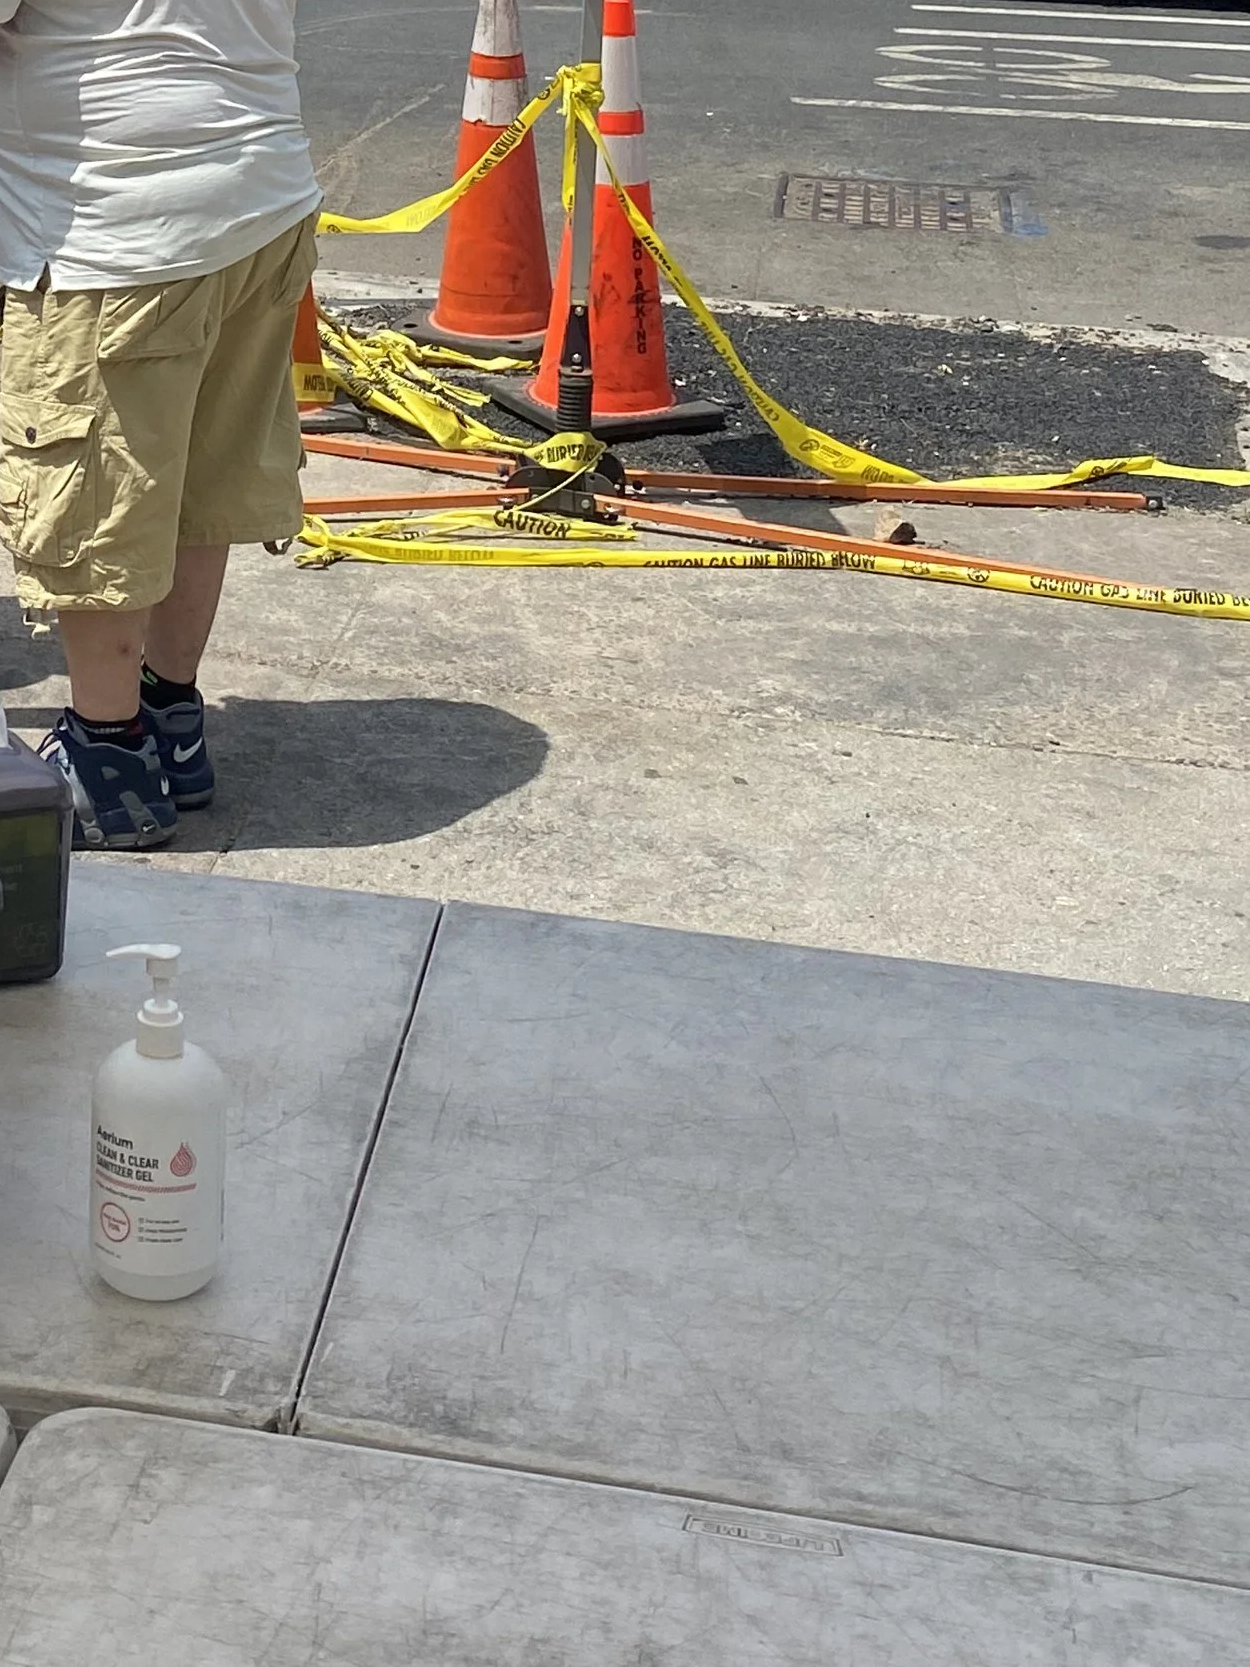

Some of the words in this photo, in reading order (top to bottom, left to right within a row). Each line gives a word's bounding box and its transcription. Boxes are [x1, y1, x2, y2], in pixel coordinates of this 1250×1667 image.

[633, 267, 647, 355] PARKING
[493, 510, 572, 540] CAUTION
[776, 549, 826, 568] BURIED
[1030, 574, 1094, 596] CAUTION
[96, 1154, 134, 1180] SANITIZER
[136, 1170, 155, 1183] GEL
[128, 1156, 159, 1170] CLEAR
